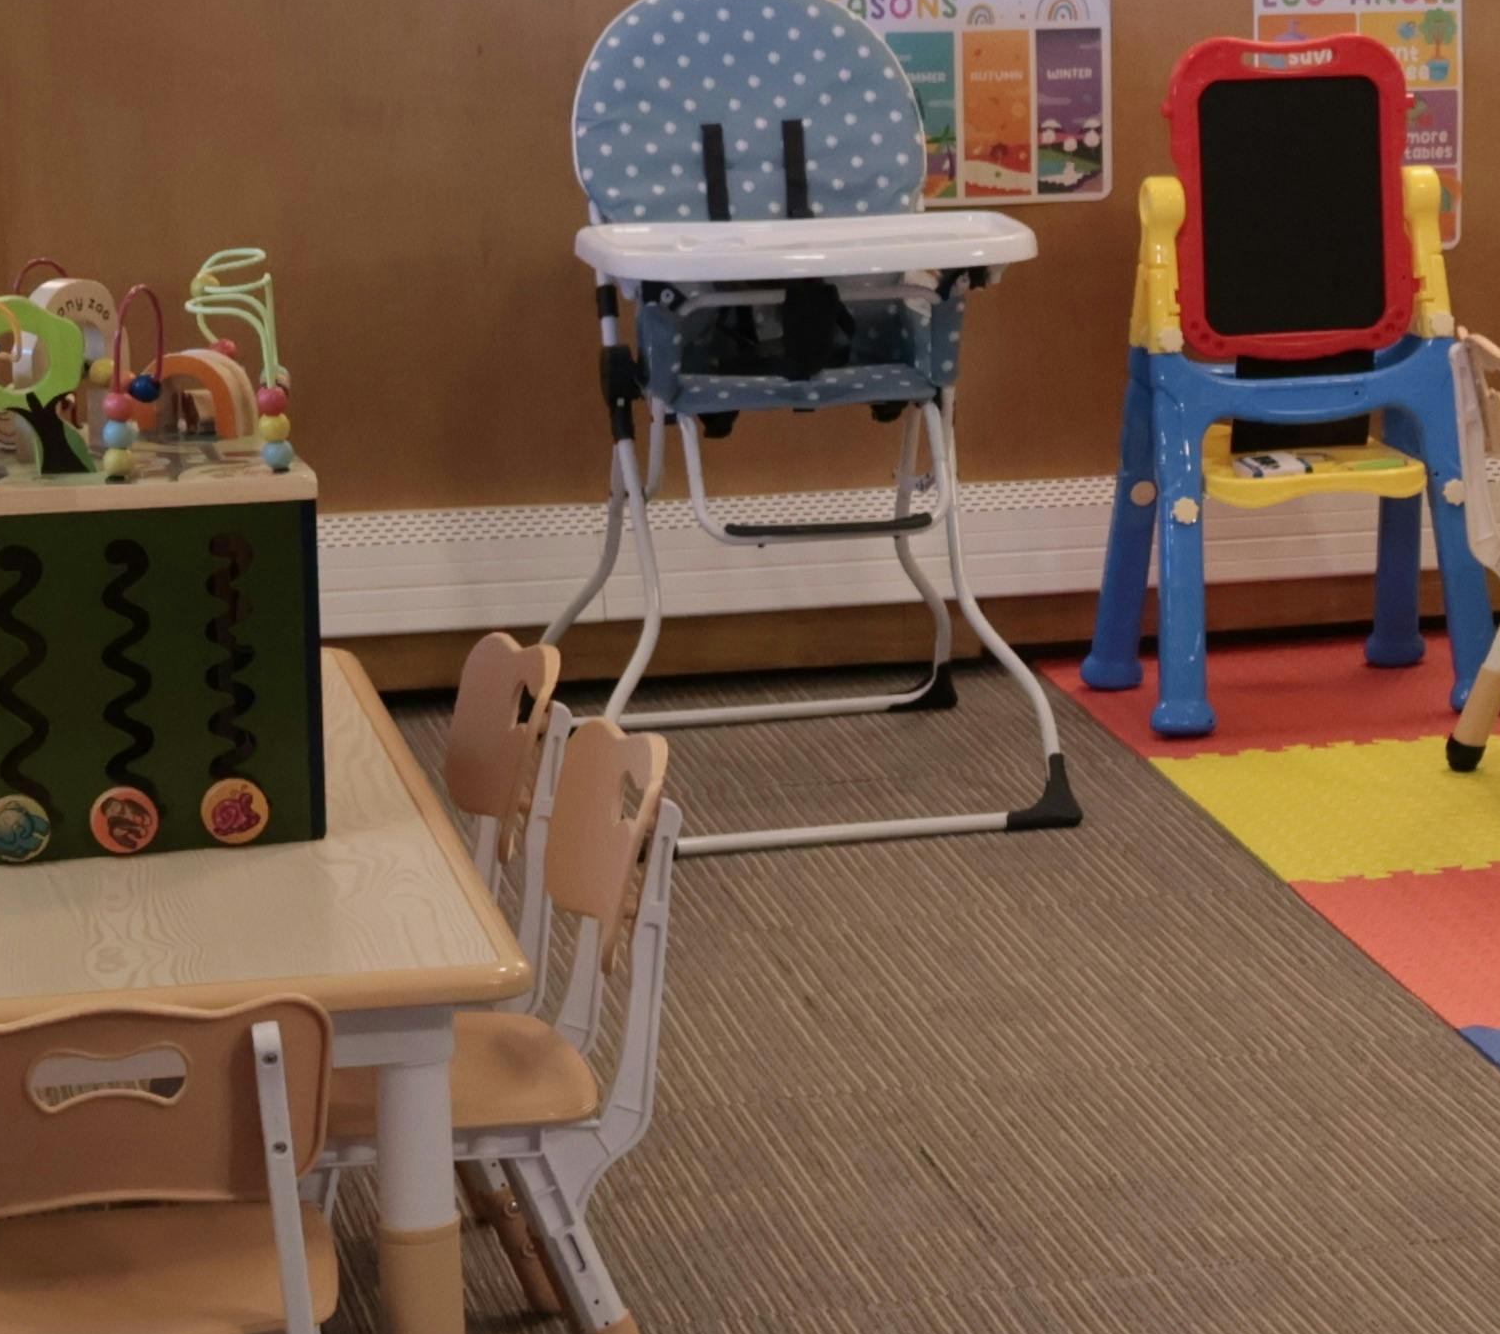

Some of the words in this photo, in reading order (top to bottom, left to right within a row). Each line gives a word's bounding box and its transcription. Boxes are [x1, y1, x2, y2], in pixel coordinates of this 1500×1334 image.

[904, 71, 946, 84] MMER
[970, 70, 1023, 83] AUTUMN
[1046, 68, 1092, 81] WINTER
[1406, 130, 1448, 144] more
[57, 297, 83, 317] any
